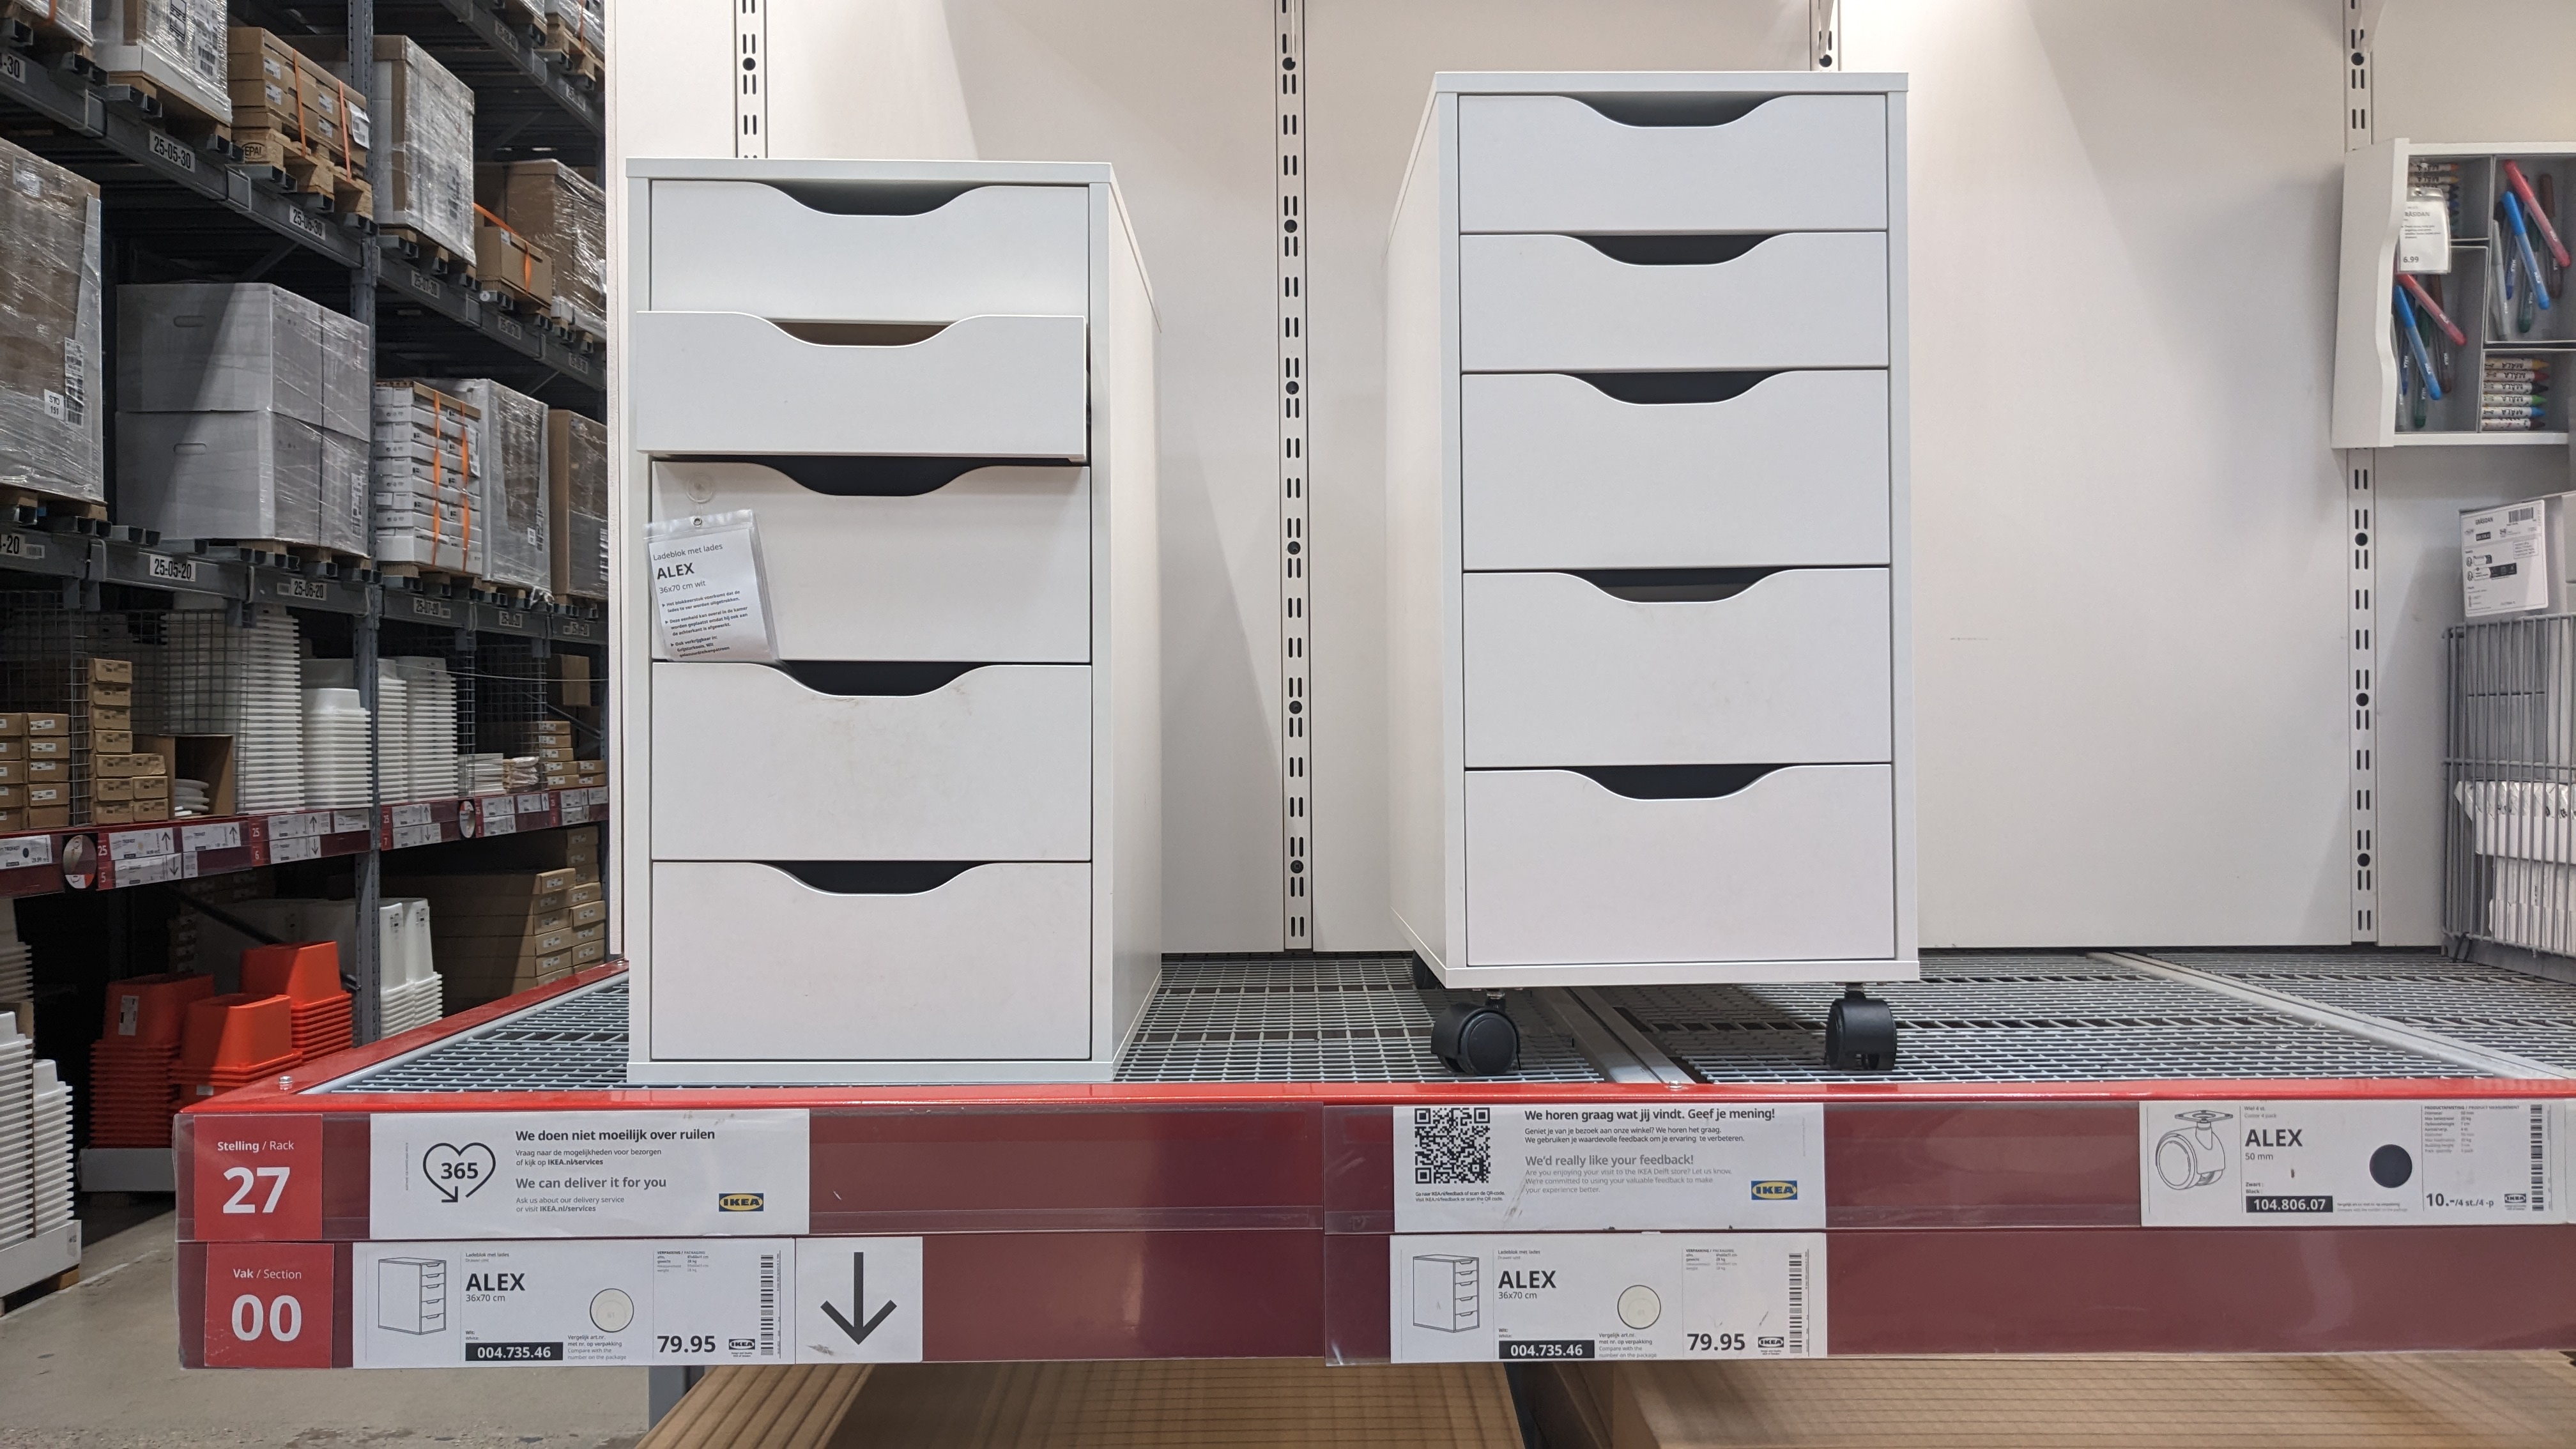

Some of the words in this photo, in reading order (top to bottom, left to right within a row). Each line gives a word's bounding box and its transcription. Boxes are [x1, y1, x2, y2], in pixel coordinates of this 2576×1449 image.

[154, 135, 191, 169] 25-05-30
[49, 395, 60, 404] STO
[50, 406, 59, 415] 151
[653, 549, 686, 561] Ladeblok
[703, 544, 723, 553] lades
[155, 558, 192, 578] 25-05-20
[657, 562, 694, 579] ALEX
[294, 581, 324, 599] 25-06-20
[659, 585, 680, 594] 36x70
[98, 845, 107, 856] 25
[101, 872, 106, 882] 5
[1524, 1110, 1542, 1120] We
[1545, 1110, 1578, 1119] horen
[1581, 1112, 1613, 1122] graag
[1616, 1110, 1638, 1119] wat
[1639, 1109, 1650, 1122] jij
[1652, 1108, 1684, 1119] vindt.
[1687, 1108, 1714, 1119] Geef
[1715, 1108, 1726, 1121] je
[1729, 1108, 1775, 1121] mening!
[515, 1131, 535, 1140] We
[538, 1130, 568, 1140] doen
[572, 1130, 595, 1140] niet
[599, 1129, 647, 1142] moeilijk
[680, 1128, 715, 1139] ruilen
[1537, 1136, 1570, 1144] gebruiken
[2245, 1129, 2303, 1147] ALEX
[217, 1141, 259, 1153] Stelling
[262, 1141, 266, 1150] /
[270, 1140, 295, 1150] Rack
[563, 1149, 612, 1157] mogelijkheden
[630, 1148, 661, 1156] bezorgen
[1555, 1155, 1586, 1168] really
[1589, 1155, 1608, 1165] like
[1611, 1157, 1636, 1167] your
[1639, 1154, 1693, 1165] feedback!
[441, 1162, 478, 1179] 365
[1552, 1169, 1581, 1177] enjoying
[515, 1178, 535, 1188] We
[564, 1177, 607, 1188] deliver
[610, 1177, 619, 1187] it
[622, 1176, 640, 1187] for
[643, 1179, 666, 1190] you
[1756, 1186, 1794, 1194] IKEA
[223, 1167, 290, 1214] 27
[2254, 1199, 2326, 1211] 104.806.07
[233, 1269, 254, 1278] Vak
[256, 1269, 261, 1278] /
[263, 1268, 302, 1279] Section
[1498, 1270, 1556, 1289] ALEX
[465, 1273, 526, 1291] ALEX
[466, 1294, 491, 1302] 36x70
[1498, 1291, 1522, 1300] 36x70
[232, 1294, 302, 1342] 00
[657, 1335, 716, 1353] 79.95
[1687, 1333, 1745, 1351] 79.95
[477, 1346, 551, 1358] 004.735.46
[1510, 1344, 1583, 1356] 004.735.46
